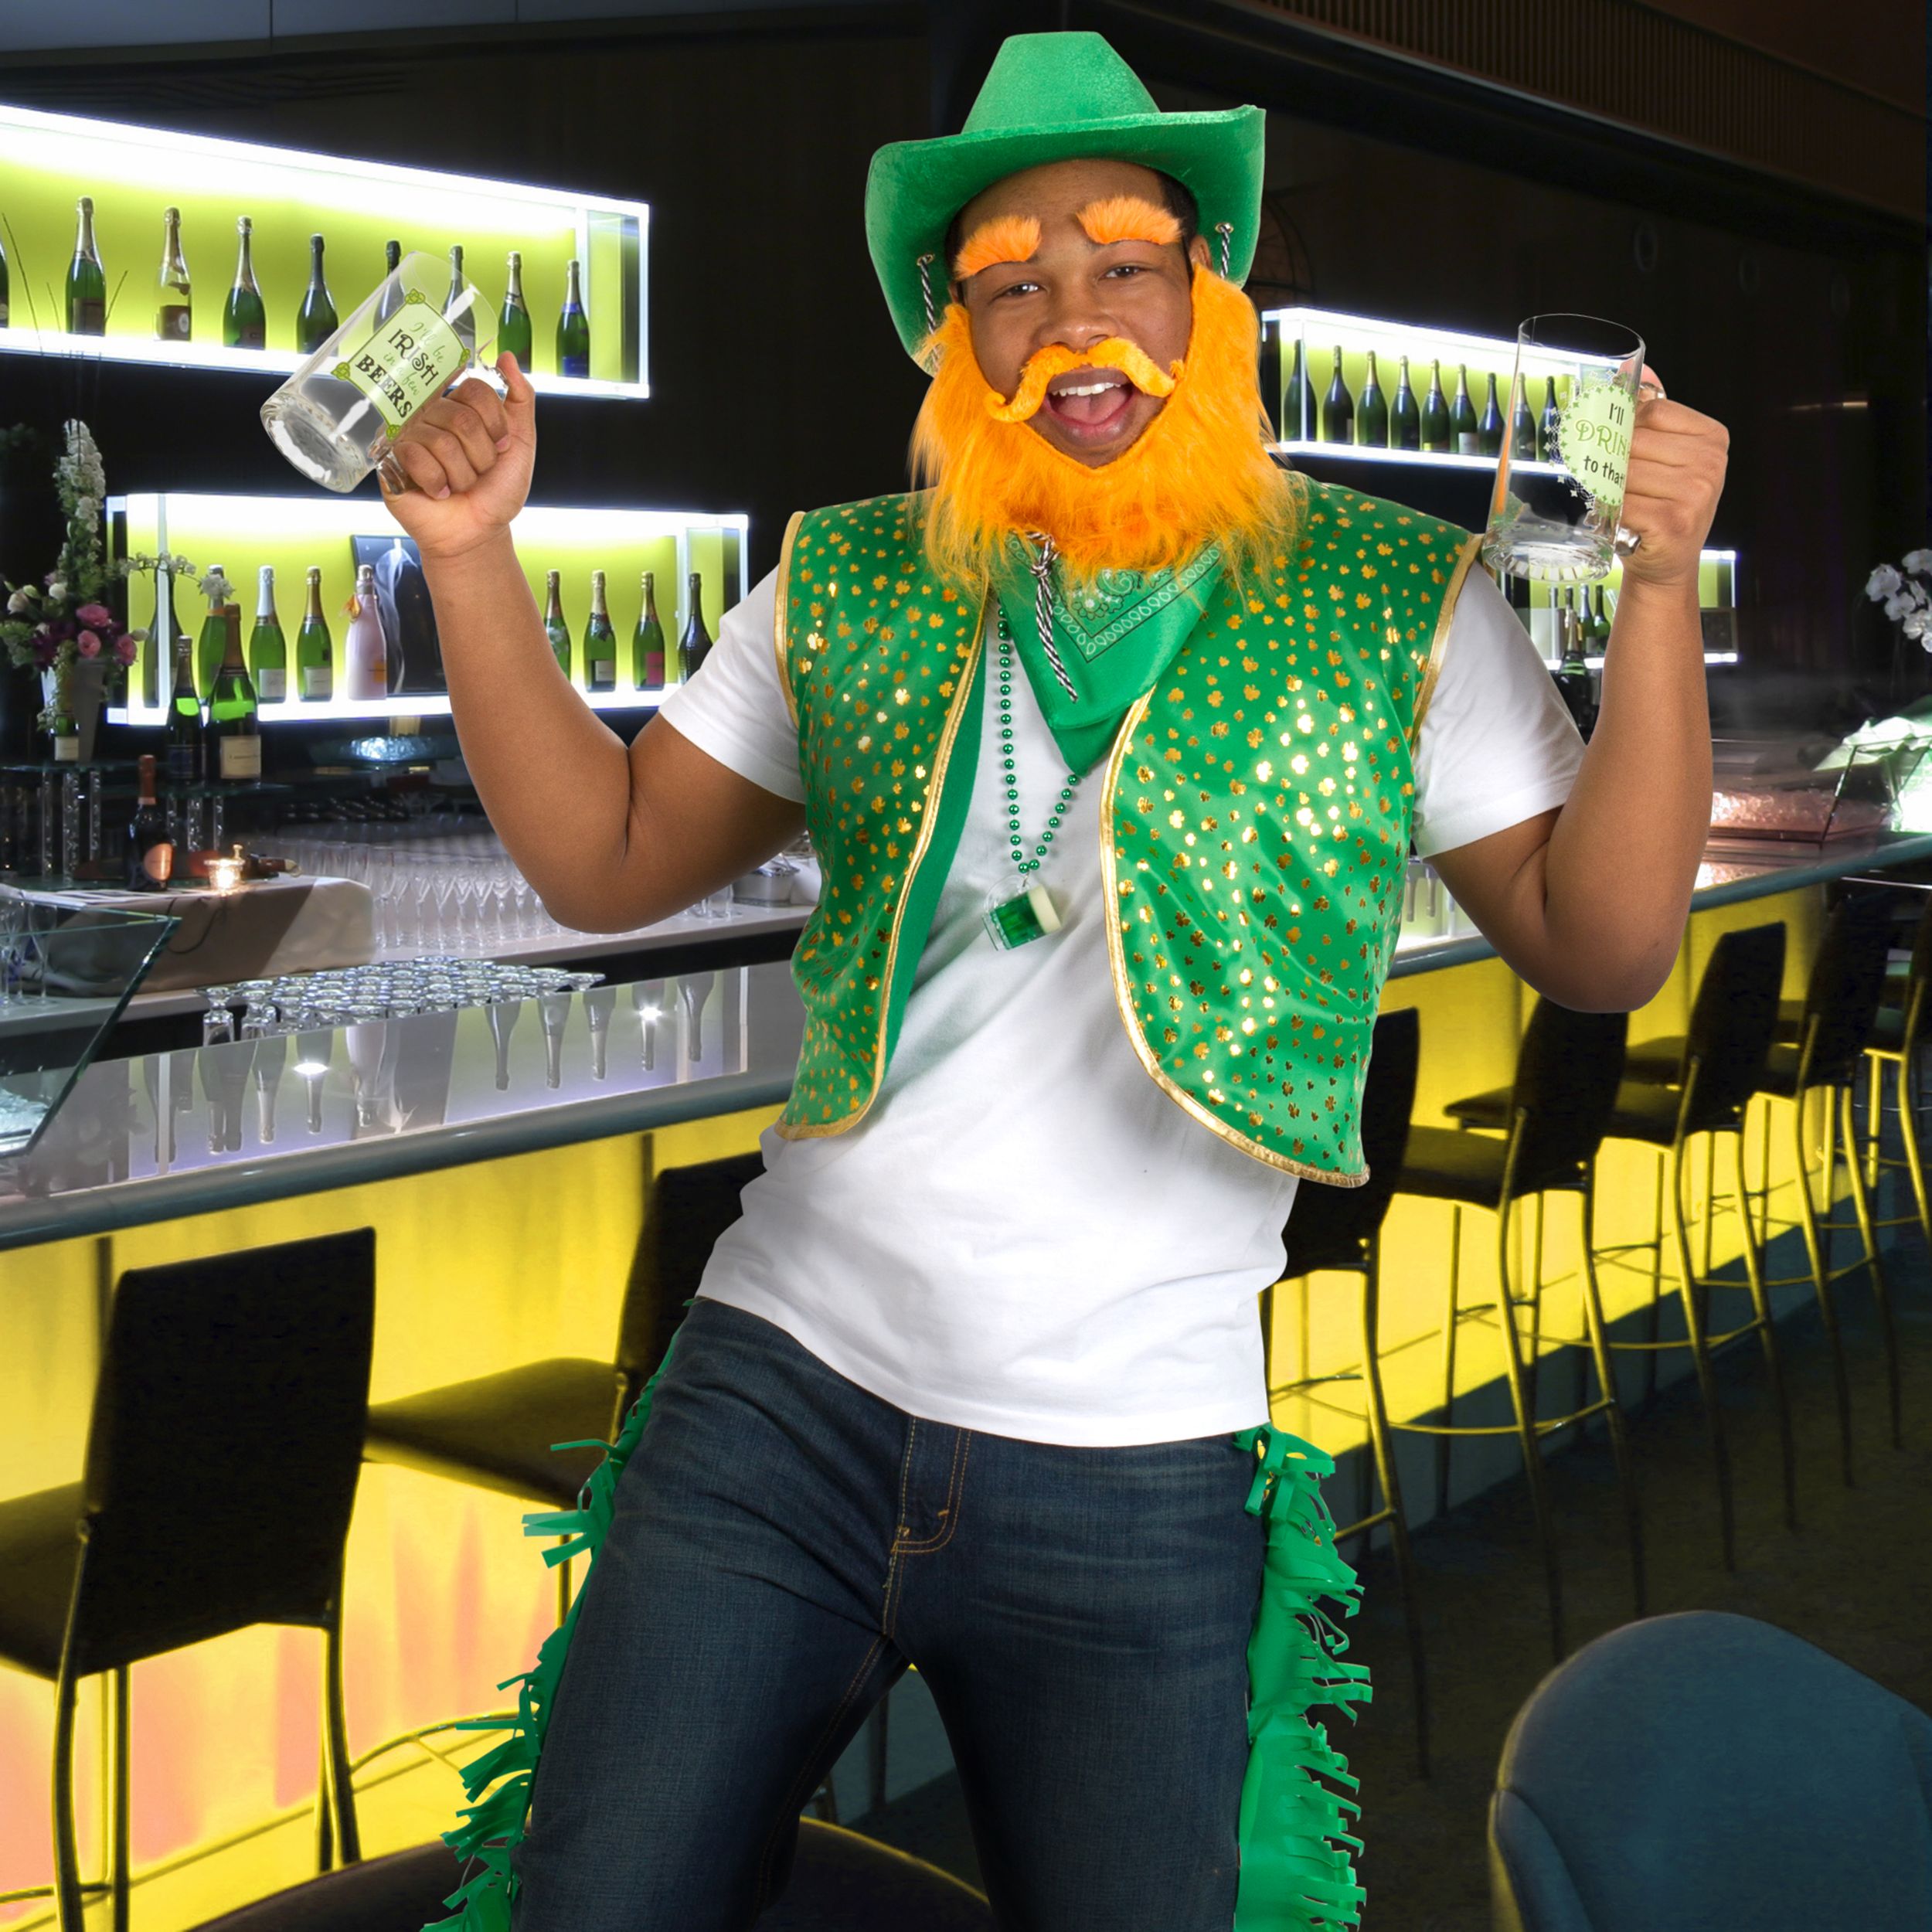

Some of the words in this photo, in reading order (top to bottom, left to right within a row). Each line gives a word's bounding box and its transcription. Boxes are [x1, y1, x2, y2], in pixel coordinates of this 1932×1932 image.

[383, 352, 396, 366] in
[388, 328, 439, 386] IRISH
[432, 345, 446, 363] be
[355, 354, 413, 418] BEERS
[1608, 403, 1624, 426] I'll
[1575, 419, 1629, 457] DRIN
[1583, 455, 1599, 473] to
